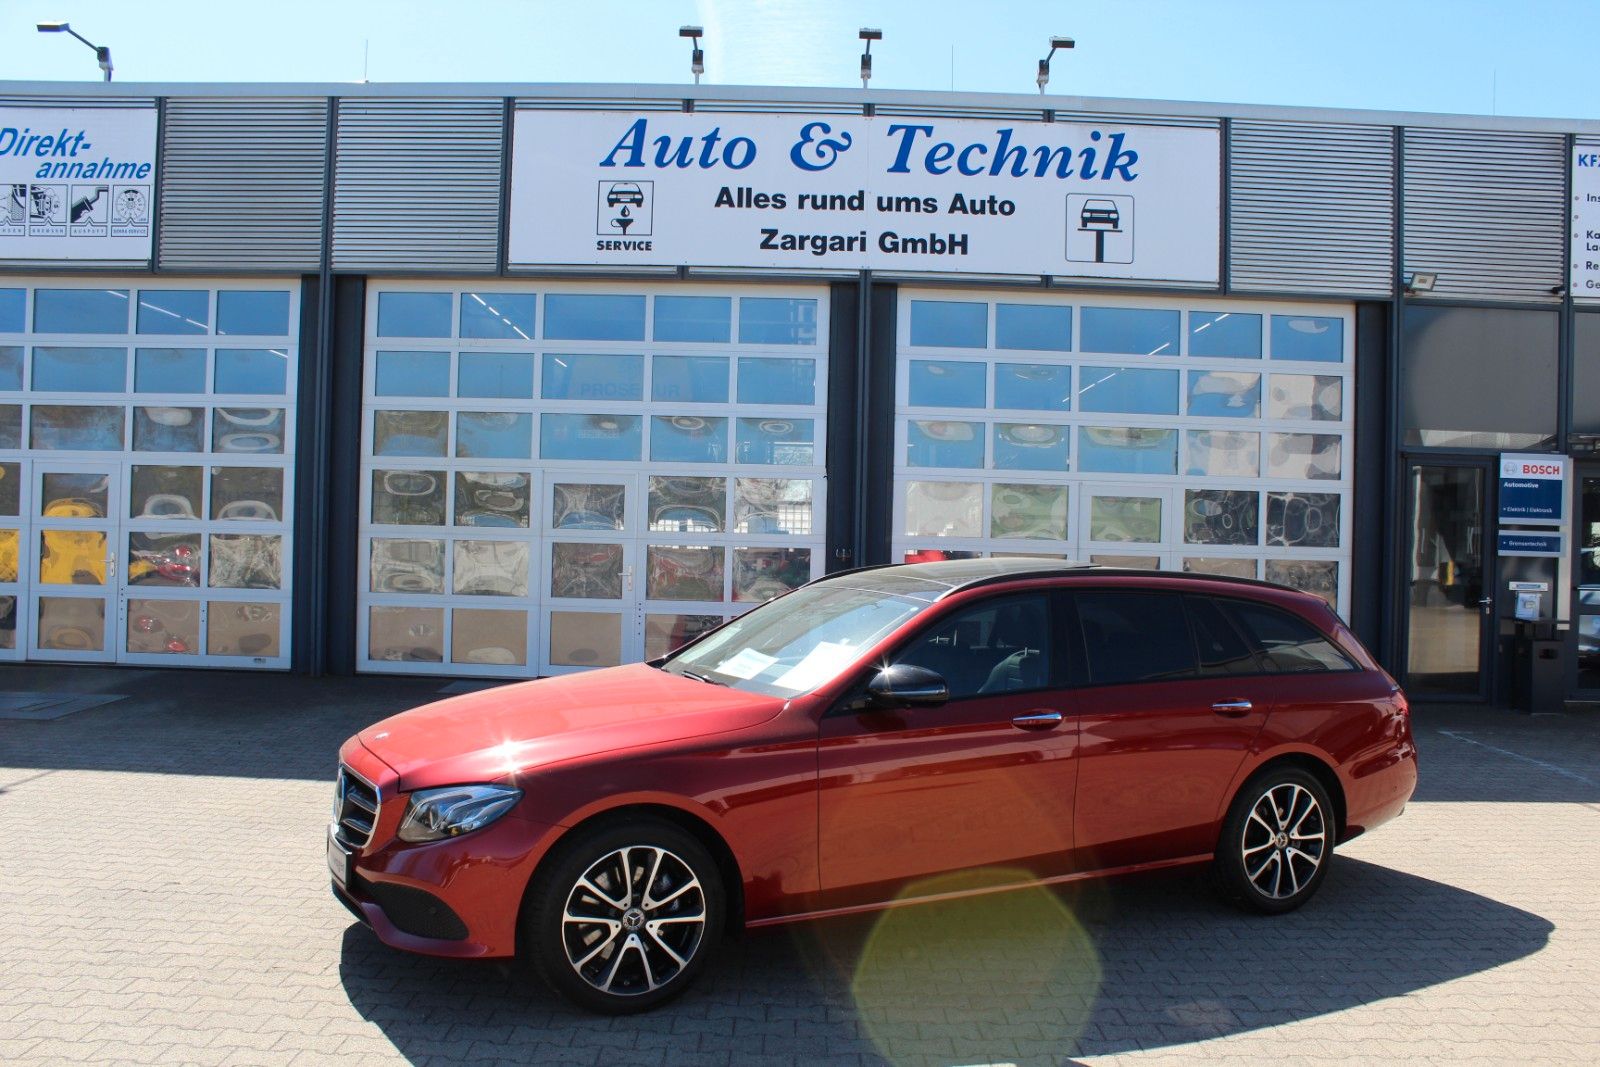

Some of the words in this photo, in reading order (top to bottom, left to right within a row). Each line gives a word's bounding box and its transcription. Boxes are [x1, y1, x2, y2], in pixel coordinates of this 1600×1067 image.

[0, 128, 91, 157] Direkt-
[599, 118, 757, 170] Auto
[789, 121, 852, 172] &
[886, 124, 1140, 182] Technik
[35, 157, 151, 179] annahme
[1578, 154, 1600, 167] KF
[714, 187, 787, 210] Alles
[798, 190, 865, 212] rund
[876, 195, 938, 214] ums
[948, 193, 1016, 217] Auto
[596, 240, 653, 251] SERVICE
[759, 228, 866, 256] Zargari
[878, 231, 969, 255] GmbH
[1522, 464, 1560, 475] BOSCH
